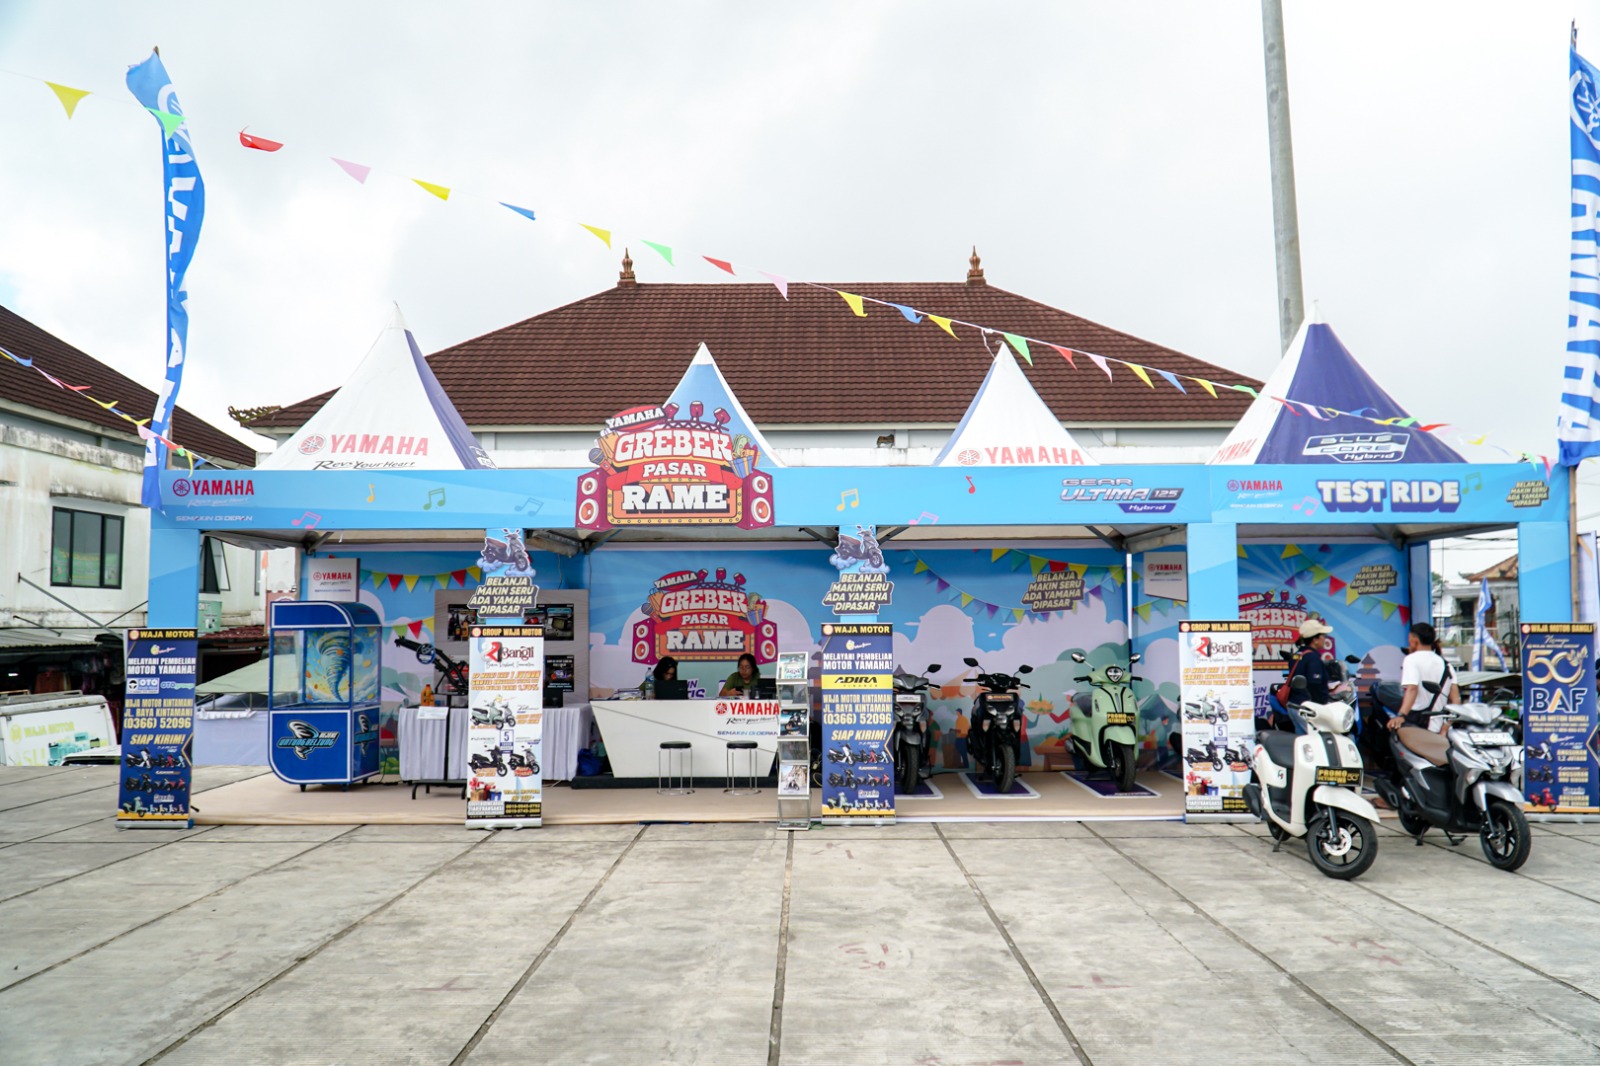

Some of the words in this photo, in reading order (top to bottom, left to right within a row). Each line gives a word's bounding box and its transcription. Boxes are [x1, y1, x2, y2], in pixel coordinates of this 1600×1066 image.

[605, 407, 665, 429] YAMAHA
[1320, 434, 1394, 445] BLUE
[330, 433, 429, 457] YAMAHA
[615, 430, 732, 462] GREBEK
[1320, 444, 1392, 454] CORE
[985, 445, 1085, 467] YAMAHA
[1344, 452, 1395, 462] Hybrid
[643, 462, 707, 478] PASAR
[192, 479, 254, 496] YAMAHA
[1062, 478, 1133, 487] GEAR
[1240, 480, 1283, 491] YAMAHA
[621, 484, 728, 511] RAME
[1059, 487, 1151, 501] ULTIMA
[1153, 489, 1180, 498] 125
[1317, 481, 1386, 504] TEST
[1391, 481, 1460, 504] RIDE
[1128, 503, 1167, 512] Hybrid
[1156, 563, 1182, 571] YAMAHA
[322, 572, 352, 581] YAMAHA
[654, 572, 698, 588] YAMAHA
[841, 573, 882, 583] BELANJA
[1037, 572, 1075, 582] BELANJA
[486, 577, 528, 587] BELANJA
[1029, 583, 1057, 591] MAKIN
[1059, 581, 1082, 589] SERU
[477, 586, 508, 596] MAKIN
[509, 586, 534, 595] SERU
[832, 583, 862, 592] MAKIN
[864, 583, 889, 592] SERU
[470, 596, 490, 605] ADA
[492, 595, 532, 605] YAMAHA
[825, 592, 845, 601] ADA
[848, 592, 887, 601] YAMAHA
[1024, 592, 1042, 601] ADA
[1044, 589, 1081, 599] YAMAHA
[660, 589, 748, 614] GREBEK
[835, 602, 876, 611] DIPASAR
[1032, 600, 1070, 609] DIPASAR
[480, 605, 520, 614] DIPASAR
[681, 613, 728, 625] PASAR
[482, 628, 502, 636] GROUP
[503, 628, 520, 636] WAJA
[521, 628, 542, 636] MOTOR
[1191, 623, 1210, 631] GROUP
[1211, 623, 1228, 631] WAJA
[1252, 629, 1293, 640] PASAR
[666, 630, 744, 651] RAME
[127, 657, 159, 665] MELAYANI
[823, 661, 852, 670] MOTOR
[854, 661, 892, 670] YAMAHA!
[127, 665, 156, 674] MOTOR
[158, 665, 196, 674] YAMAHA!
[1527, 649, 1586, 684] 50
[834, 676, 877, 684] ADIRA
[840, 694, 860, 703] MOTOR
[1529, 687, 1588, 713] BAF
[124, 708, 134, 717] JL.
[136, 708, 154, 717] RAYA
[730, 702, 780, 715] YAMAHA
[823, 703, 834, 713] JL.
[836, 703, 853, 712] RAYA
[854, 703, 892, 712] KINTAMANI
[124, 718, 157, 729] (0366)
[160, 718, 191, 729] 52096
[823, 713, 857, 725] (0366)
[859, 713, 892, 724] 52096
[24, 725, 47, 738] WAJA
[504, 731, 510, 741] 5
[831, 730, 854, 741] SIAP
[855, 730, 887, 741] KIRIM!
[1218, 726, 1224, 736] 5
[130, 734, 154, 745] SIAP
[154, 734, 186, 744] KIRIM!
[1318, 769, 1347, 777] PROMO
